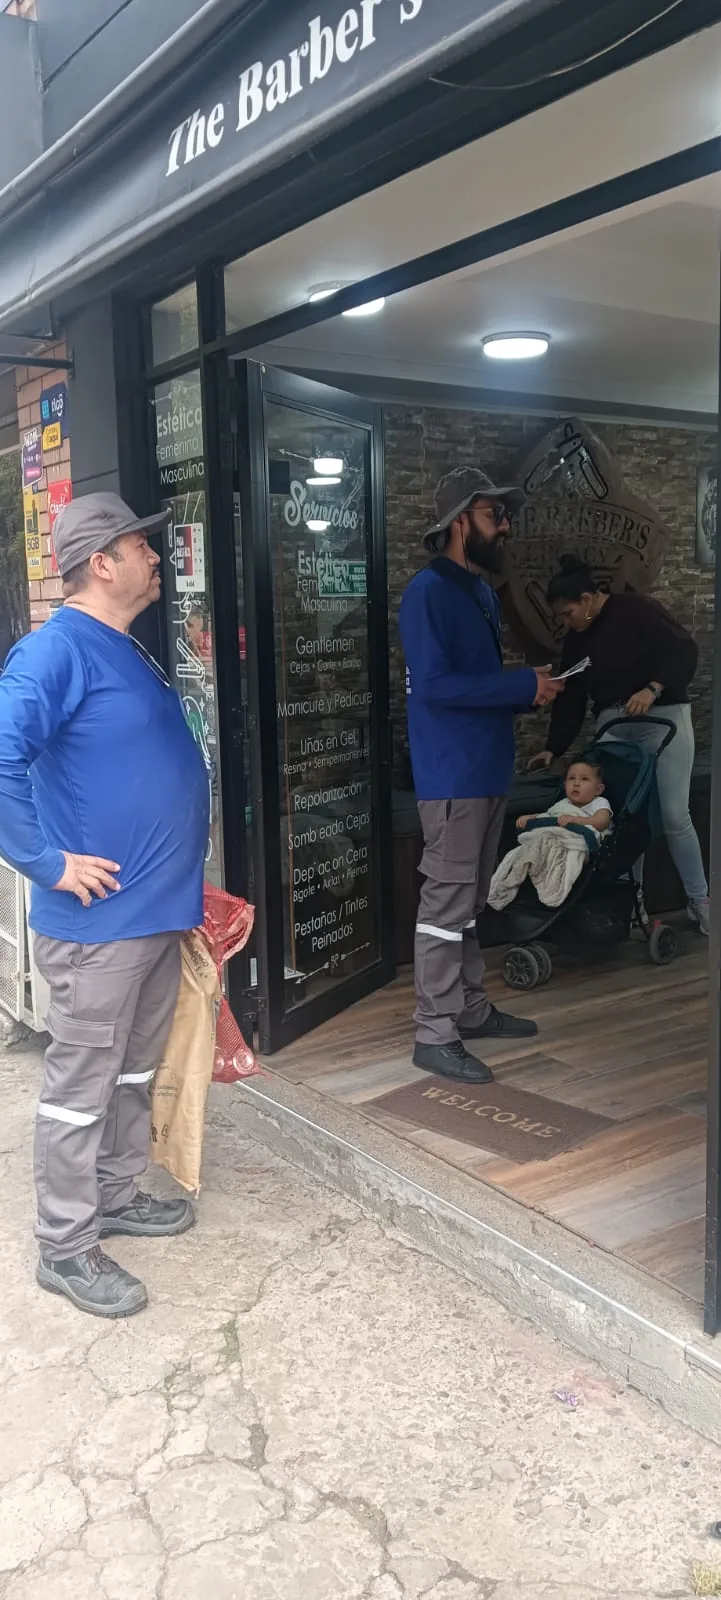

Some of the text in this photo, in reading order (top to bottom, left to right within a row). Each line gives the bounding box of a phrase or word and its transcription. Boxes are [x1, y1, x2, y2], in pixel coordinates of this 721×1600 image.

[165, 0, 424, 177] The Barber
[284, 480, 359, 530] Servicios
[296, 636, 355, 655] Gentlemen
[289, 660, 310, 677] Cejas
[277, 691, 373, 718] Manicure y Pedicure
[300, 728, 356, 756] Uñas en Gel
[284, 760, 307, 776] Resina
[294, 780, 362, 812] Repolarización
[288, 811, 370, 850] Sombeado Cejas
[346, 847, 368, 865] Cera
[293, 884, 315, 903] Bigote
[295, 910, 337, 940] Pestañas
[344, 895, 369, 917] Tintes
[312, 922, 354, 953] Peinados
[421, 1085, 561, 1139] WELCOME
